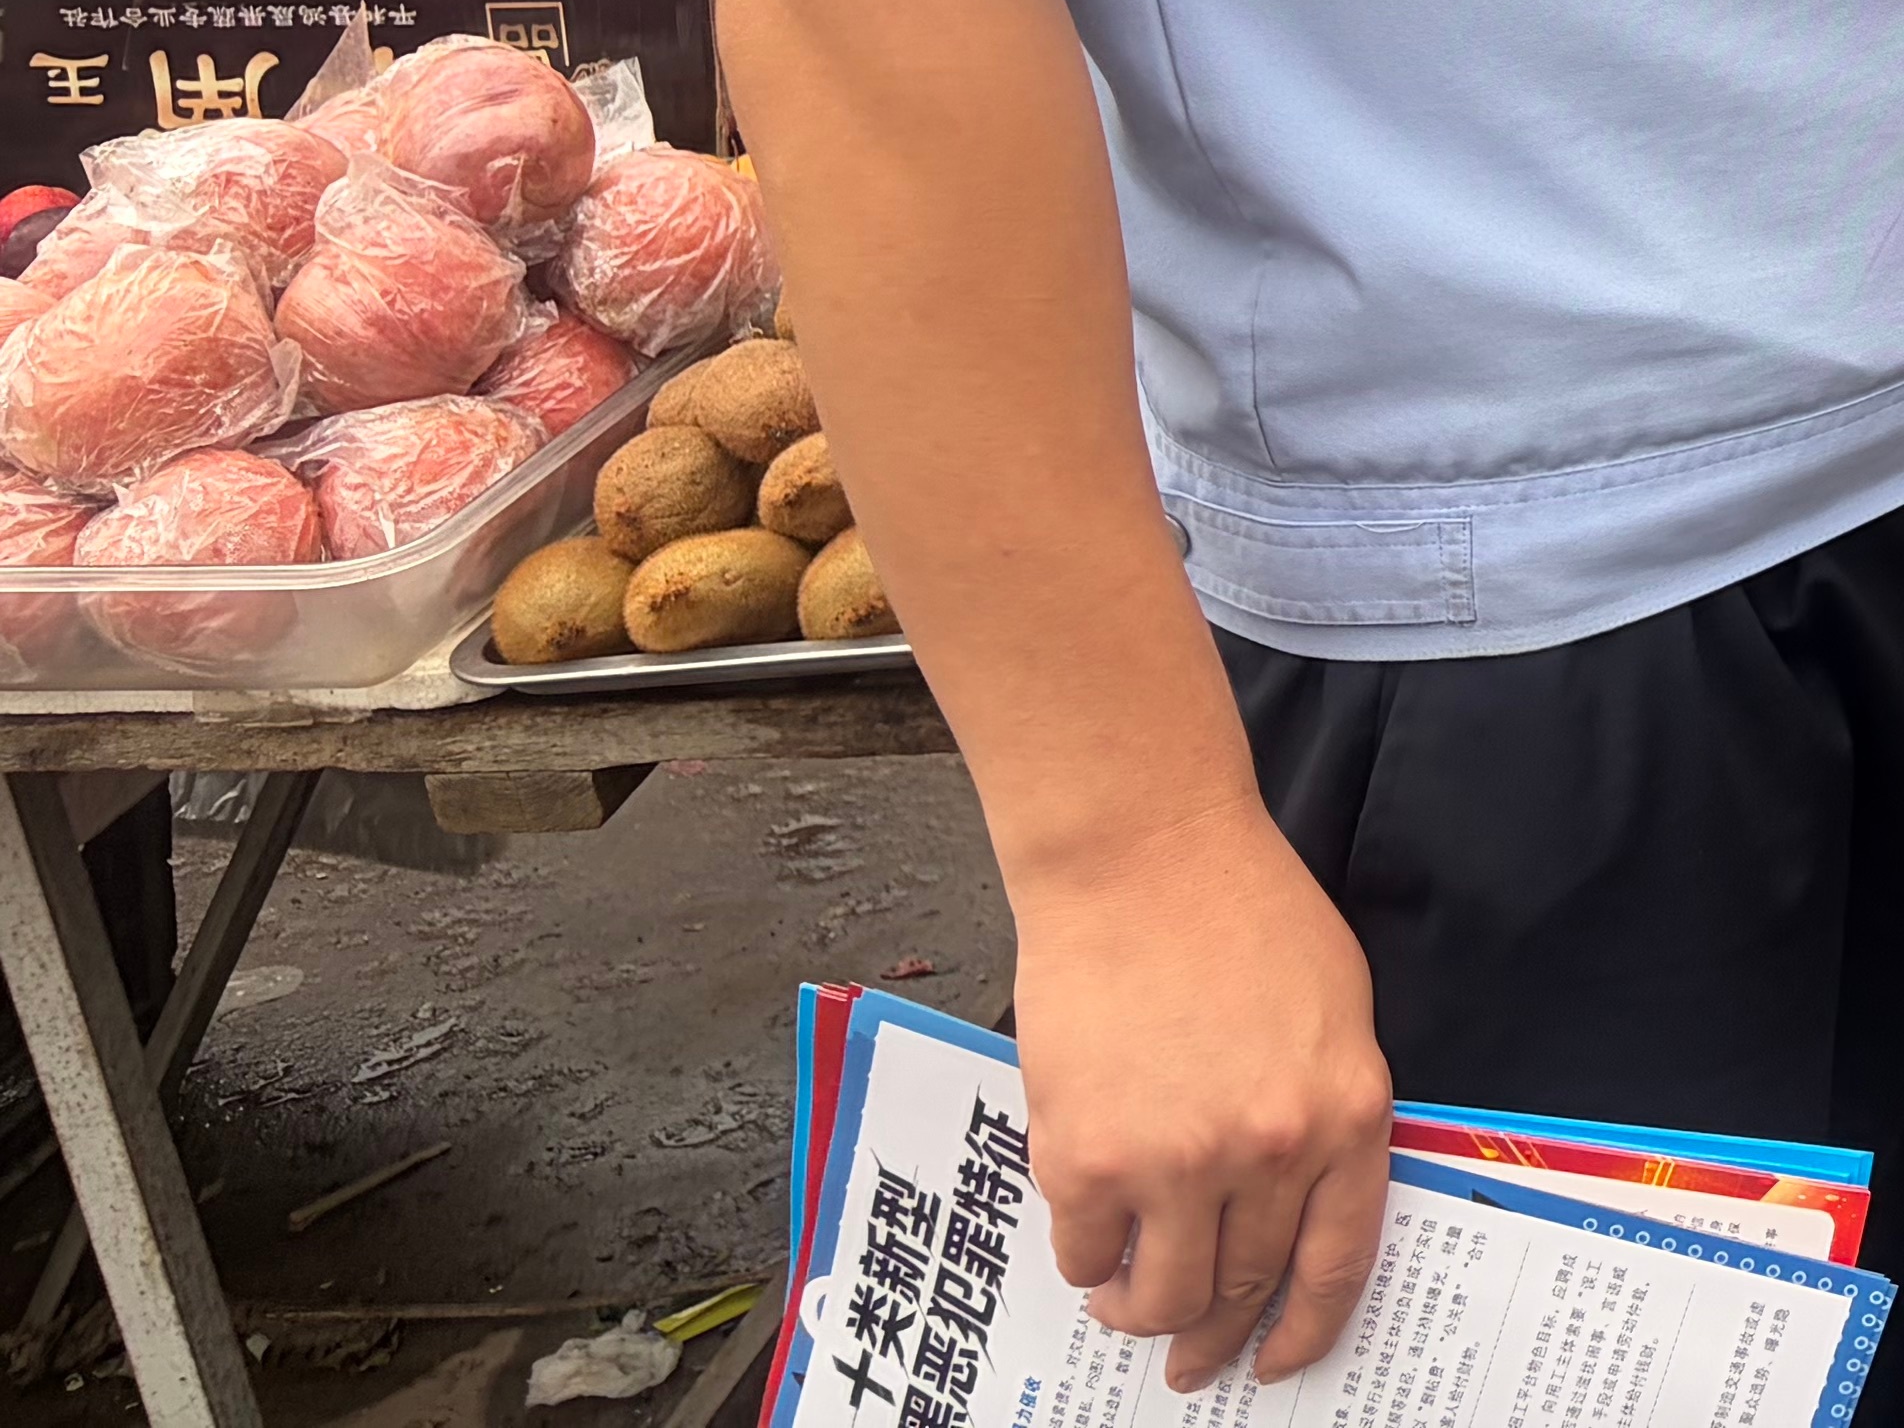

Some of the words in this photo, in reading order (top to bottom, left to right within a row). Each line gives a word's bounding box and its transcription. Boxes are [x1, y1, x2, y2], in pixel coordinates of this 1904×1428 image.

[832, 1154, 942, 1408] 十类新型
[898, 1092, 1034, 1428] 黑恶犯罪特征
